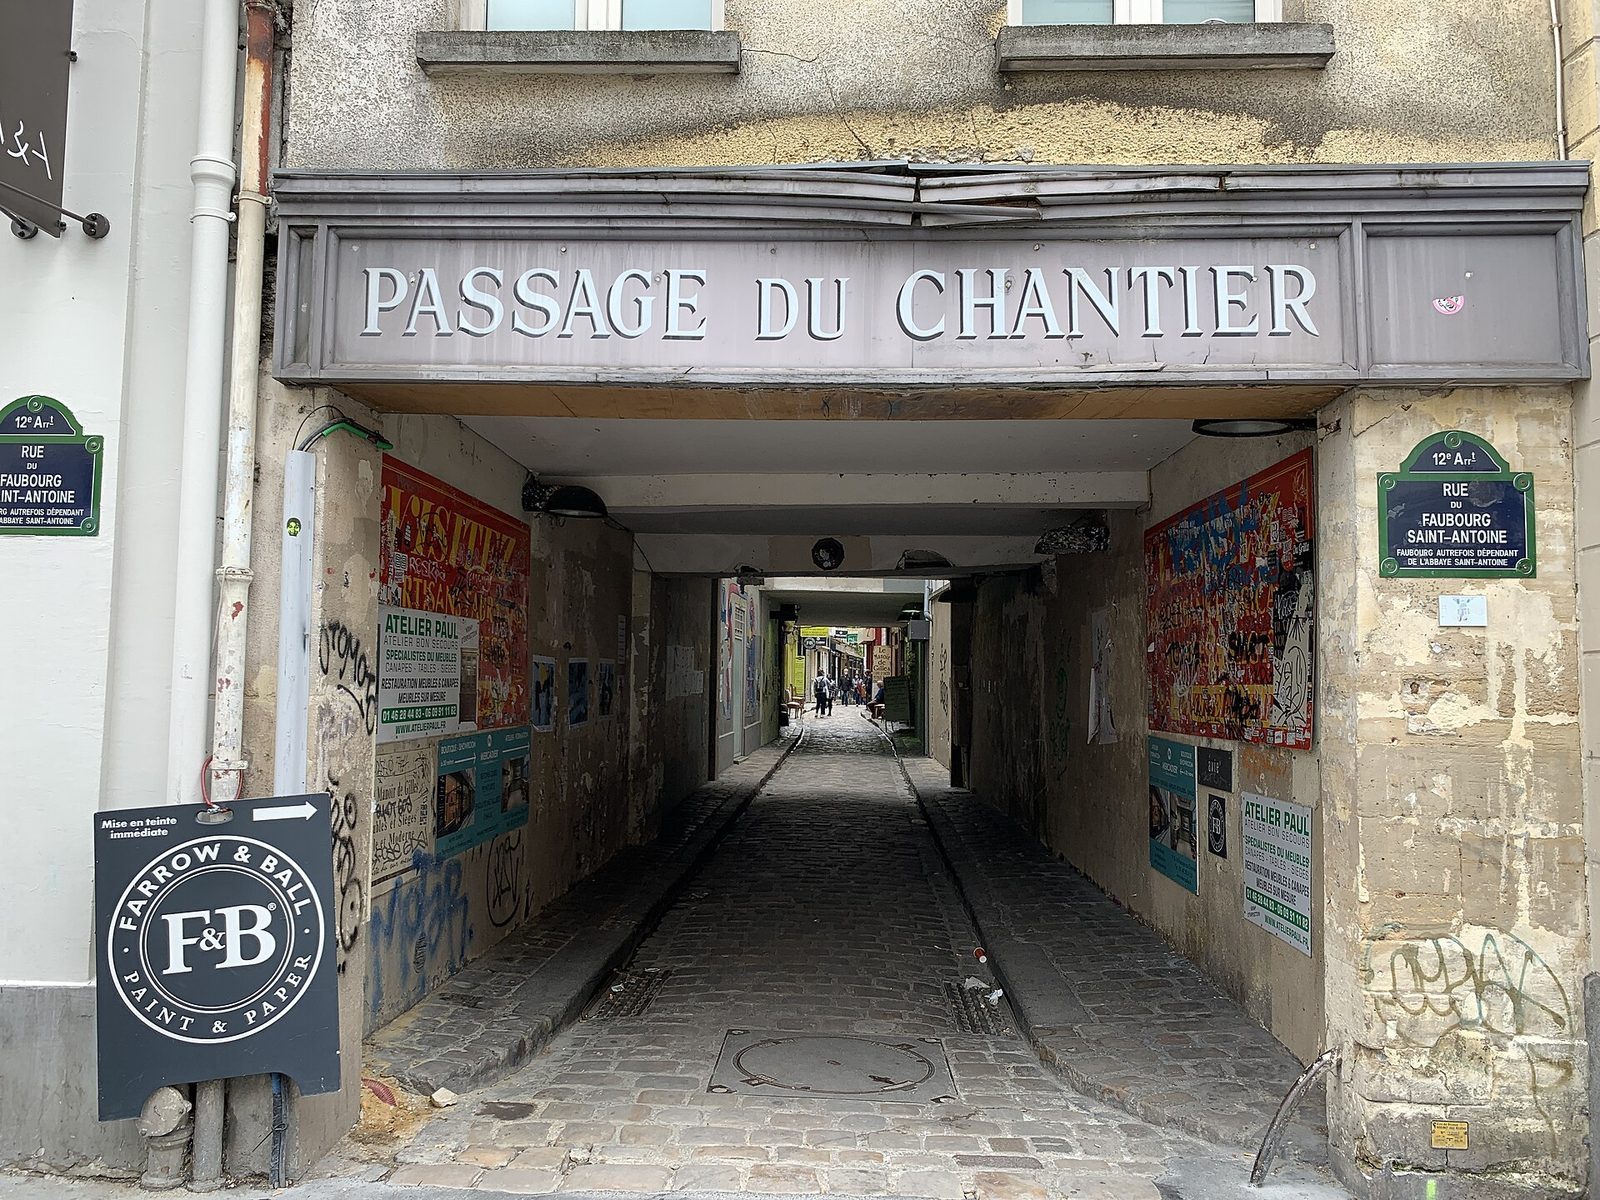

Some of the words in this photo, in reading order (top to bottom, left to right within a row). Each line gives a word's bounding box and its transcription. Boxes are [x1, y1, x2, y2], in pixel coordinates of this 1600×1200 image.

[360, 266, 707, 340] PASSAGE
[755, 277, 849, 341] DU
[896, 264, 1320, 341] CHANTIER
[21, 445, 44, 458] RUE
[26, 462, 37, 470] DU
[0, 474, 62, 487] FAUBOURG
[1443, 482, 1469, 497] RUE
[0, 490, 75, 503] INT-ANTOINE
[10, 508, 44, 516] AUTREFOIS
[46, 507, 84, 516] DÉPENDANT
[1450, 501, 1462, 509] DU
[25, 517, 74, 525] SAINT-ANTOINE
[1422, 513, 1491, 527] FAUBOURG
[1407, 529, 1508, 544] SAINT-ANTOINE
[1396, 548, 1433, 557] FAUBOURG
[1436, 548, 1475, 557] AUTREFOIS
[1477, 547, 1519, 557] DÉPENDANT
[1407, 558, 1418, 566] DE
[1419, 558, 1452, 566] L'ABBAYE
[1454, 558, 1509, 566] SAINT-ANTOINE
[385, 613, 432, 637] ATELIER
[435, 620, 458, 639] PAUL
[384, 635, 413, 647] ATELIER
[416, 638, 430, 648] BON
[432, 639, 458, 650] SECOURS
[385, 649, 426, 661] SPECIALISTES
[427, 651, 434, 661] DU
[435, 652, 457, 662] MEUBLES
[385, 662, 412, 673] CANAPES
[418, 663, 436, 673] TABLES
[382, 710, 389, 721] 01
[389, 710, 398, 720] 46
[407, 709, 414, 719] 44
[395, 721, 446, 735] WWW.ATELIERPAUL.FR
[101, 819, 128, 829] Mise
[130, 820, 143, 828] en
[145, 816, 177, 827] teinte
[1244, 801, 1281, 828] ATELIER
[1284, 811, 1309, 836] PAUL
[110, 828, 168, 839] immédiate
[1244, 819, 1266, 834] ATELIER
[1281, 828, 1310, 849] SECOURS
[1245, 834, 1277, 856] SPECIALISTES
[1277, 848, 1284, 858] DU
[1285, 849, 1309, 868] MEUBLES
[119, 843, 221, 931] FARROW
[233, 845, 252, 864] &
[260, 854, 311, 916] BALL
[1296, 914, 1301, 927] 11
[1264, 915, 1308, 946] WWW.ATELIERPAUL.FR
[123, 970, 195, 1032] PAINT
[212, 1020, 228, 1034] &
[243, 953, 312, 1026] PAPER
